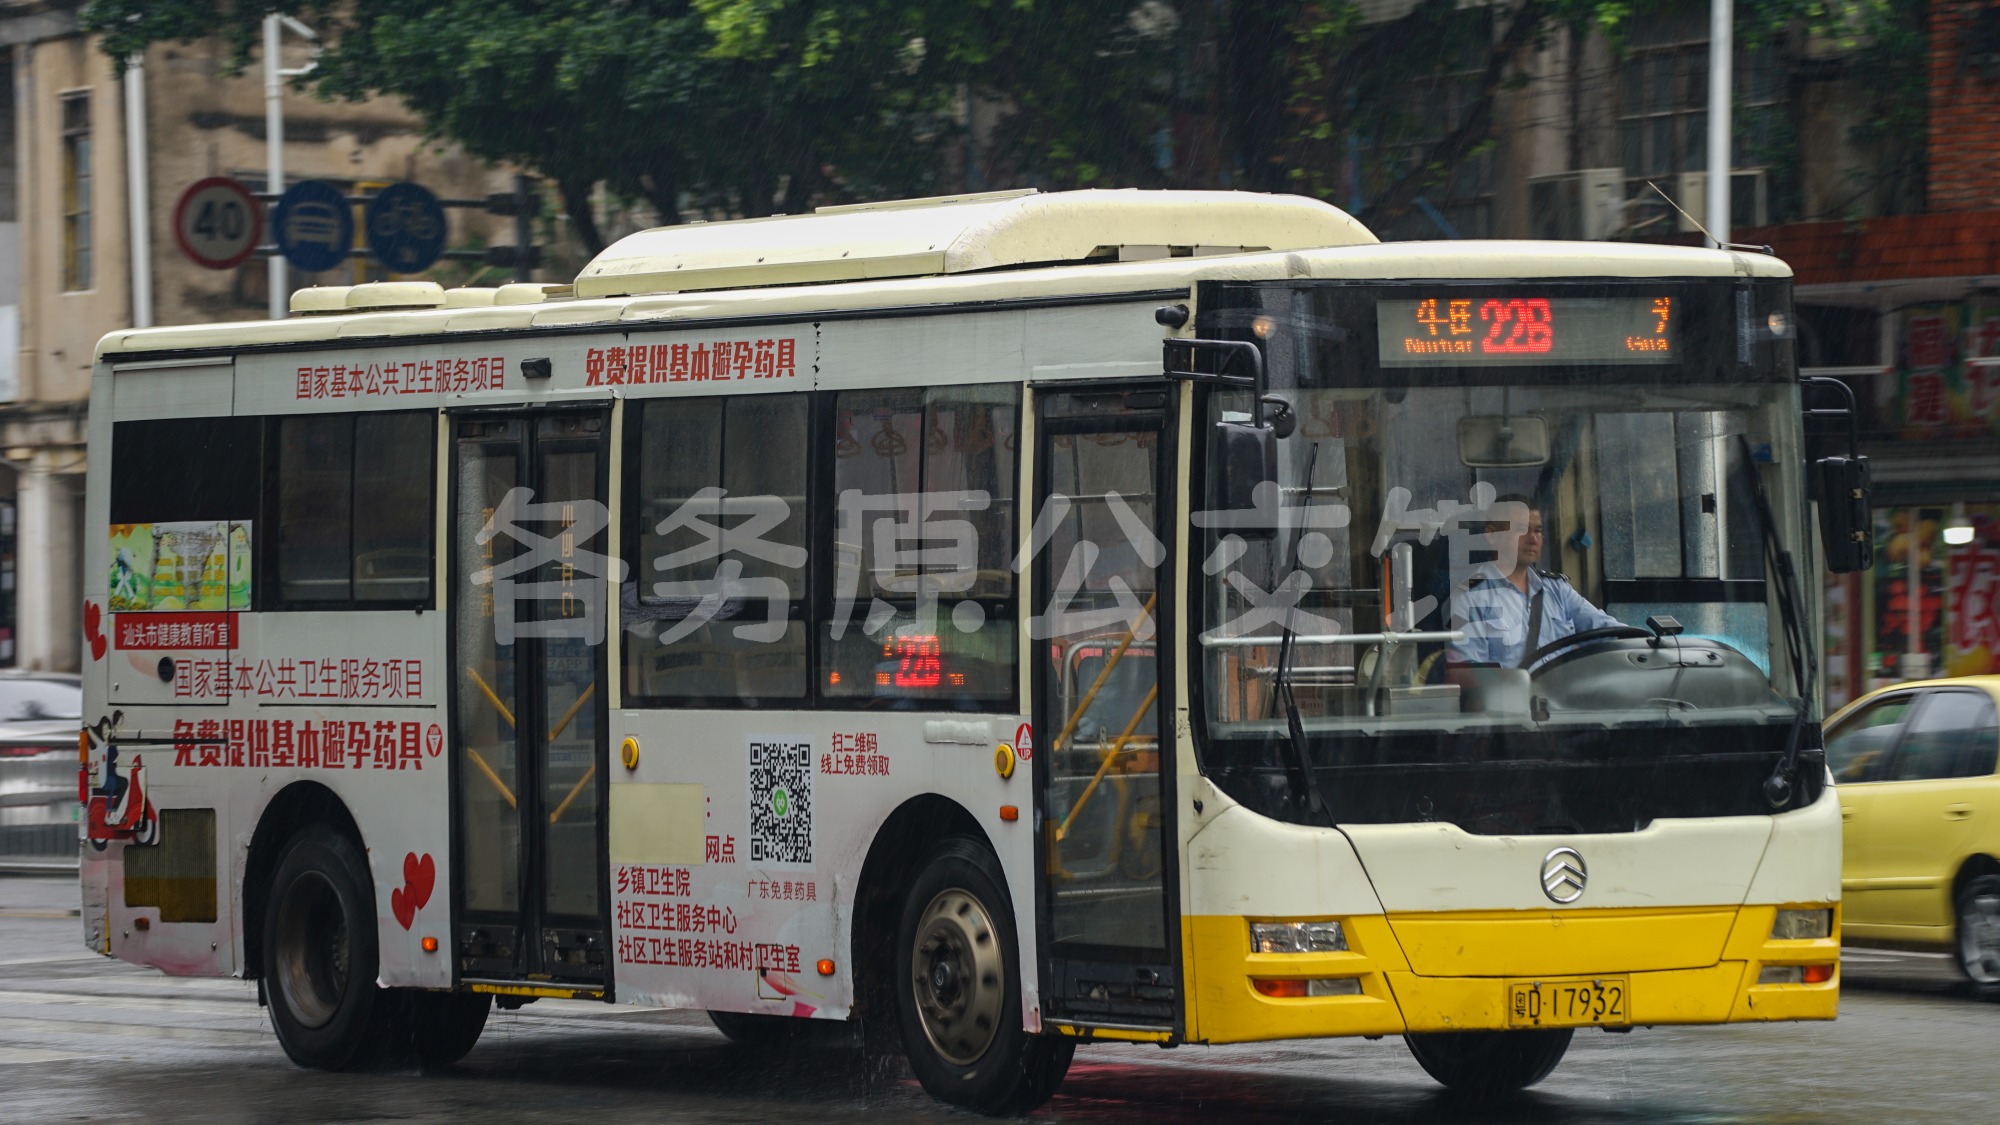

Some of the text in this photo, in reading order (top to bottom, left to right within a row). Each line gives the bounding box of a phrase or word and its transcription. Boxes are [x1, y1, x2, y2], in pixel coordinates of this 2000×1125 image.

[191, 201, 243, 241] 40
[585, 338, 796, 387] 免费提供基本避孕药具
[296, 357, 505, 400] 国家基本公共卫生服务项目
[122, 622, 215, 647] 汕头市健康教育所
[174, 656, 423, 700] 国家基本公共卫生服务项目
[172, 718, 424, 771] 免费提供基本避孕药具
[831, 732, 878, 754] 扫二维码
[1020, 748, 1031, 760] UP
[1021, 731, 1030, 746] 上
[820, 753, 890, 776] 线上免费领取
[705, 834, 736, 864] 网点
[617, 866, 691, 897] 乡镇卫生院
[747, 879, 817, 901] 广东免费药具
[617, 901, 737, 935] 社区卫生服务中心
[618, 935, 802, 974] 社区卫生服务站和村卫生室
